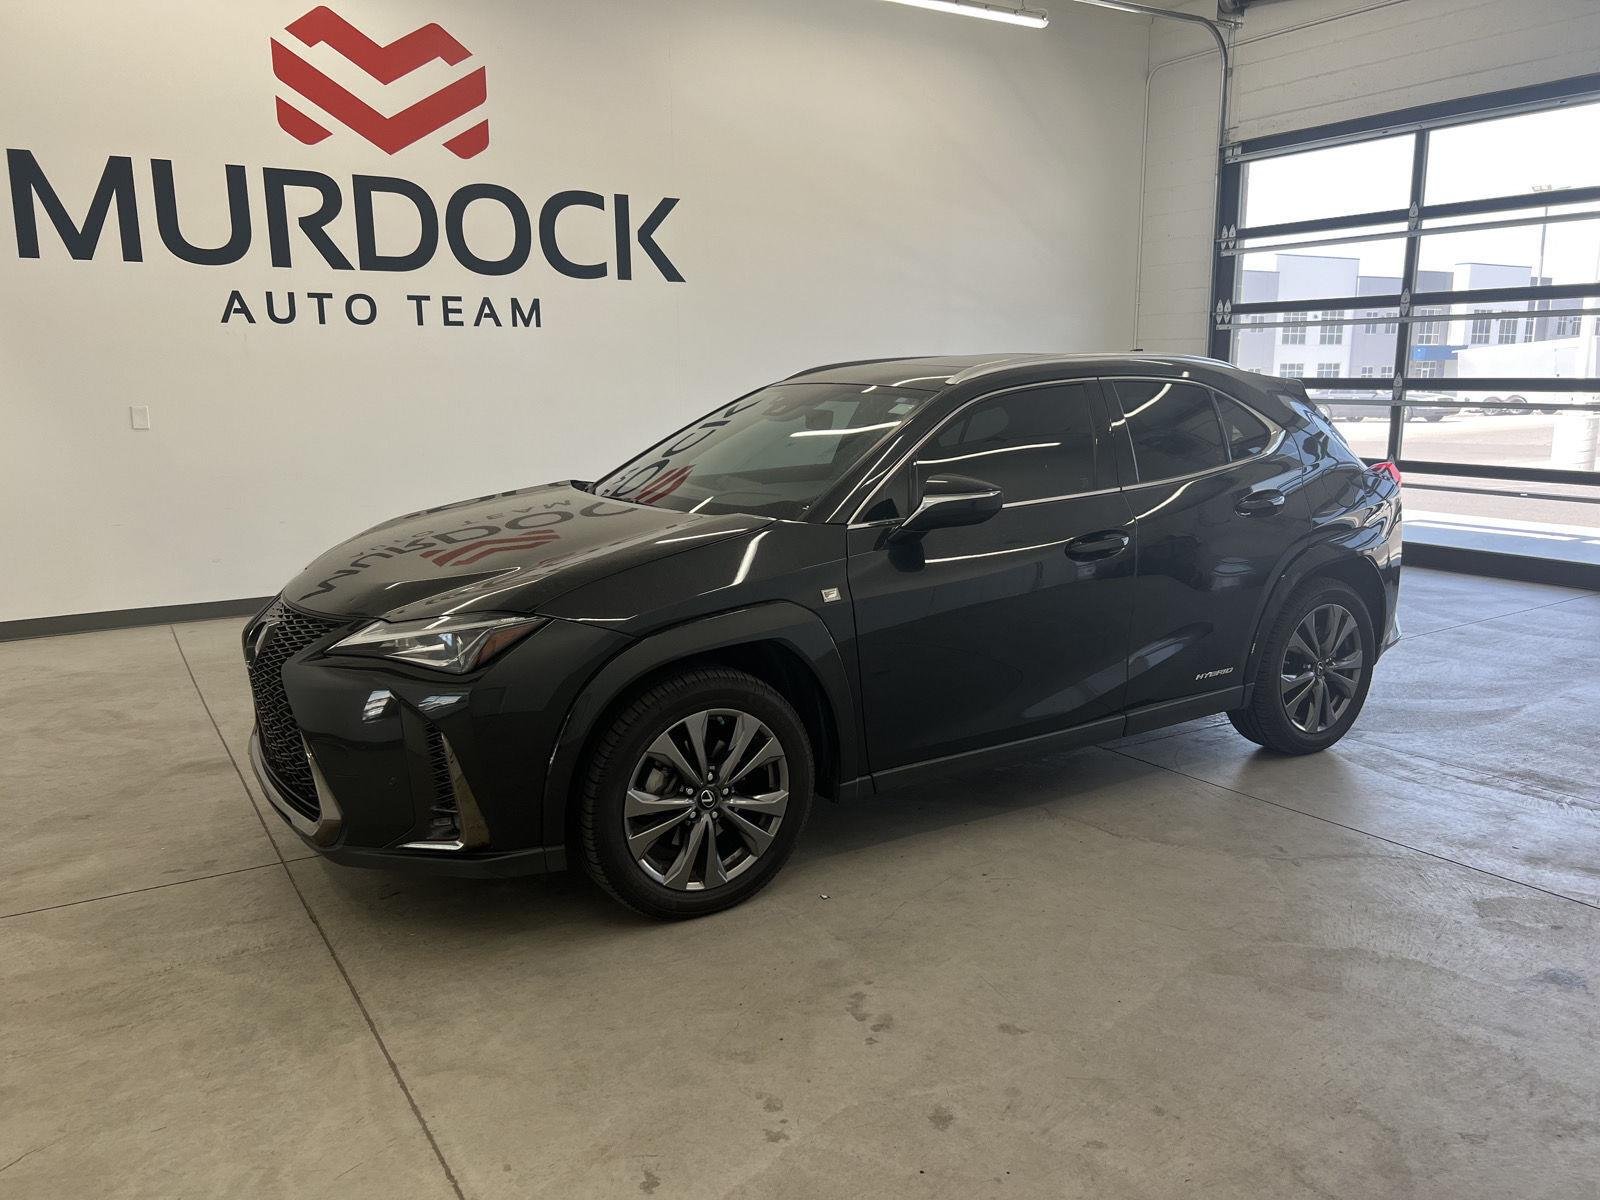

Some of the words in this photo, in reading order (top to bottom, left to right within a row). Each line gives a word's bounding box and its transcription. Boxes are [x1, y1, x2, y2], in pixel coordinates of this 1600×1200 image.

[6, 149, 687, 283] MURDOCK
[221, 290, 378, 326] AUTO
[407, 294, 542, 329] TEAM
[1195, 667, 1234, 681] HYBRID
